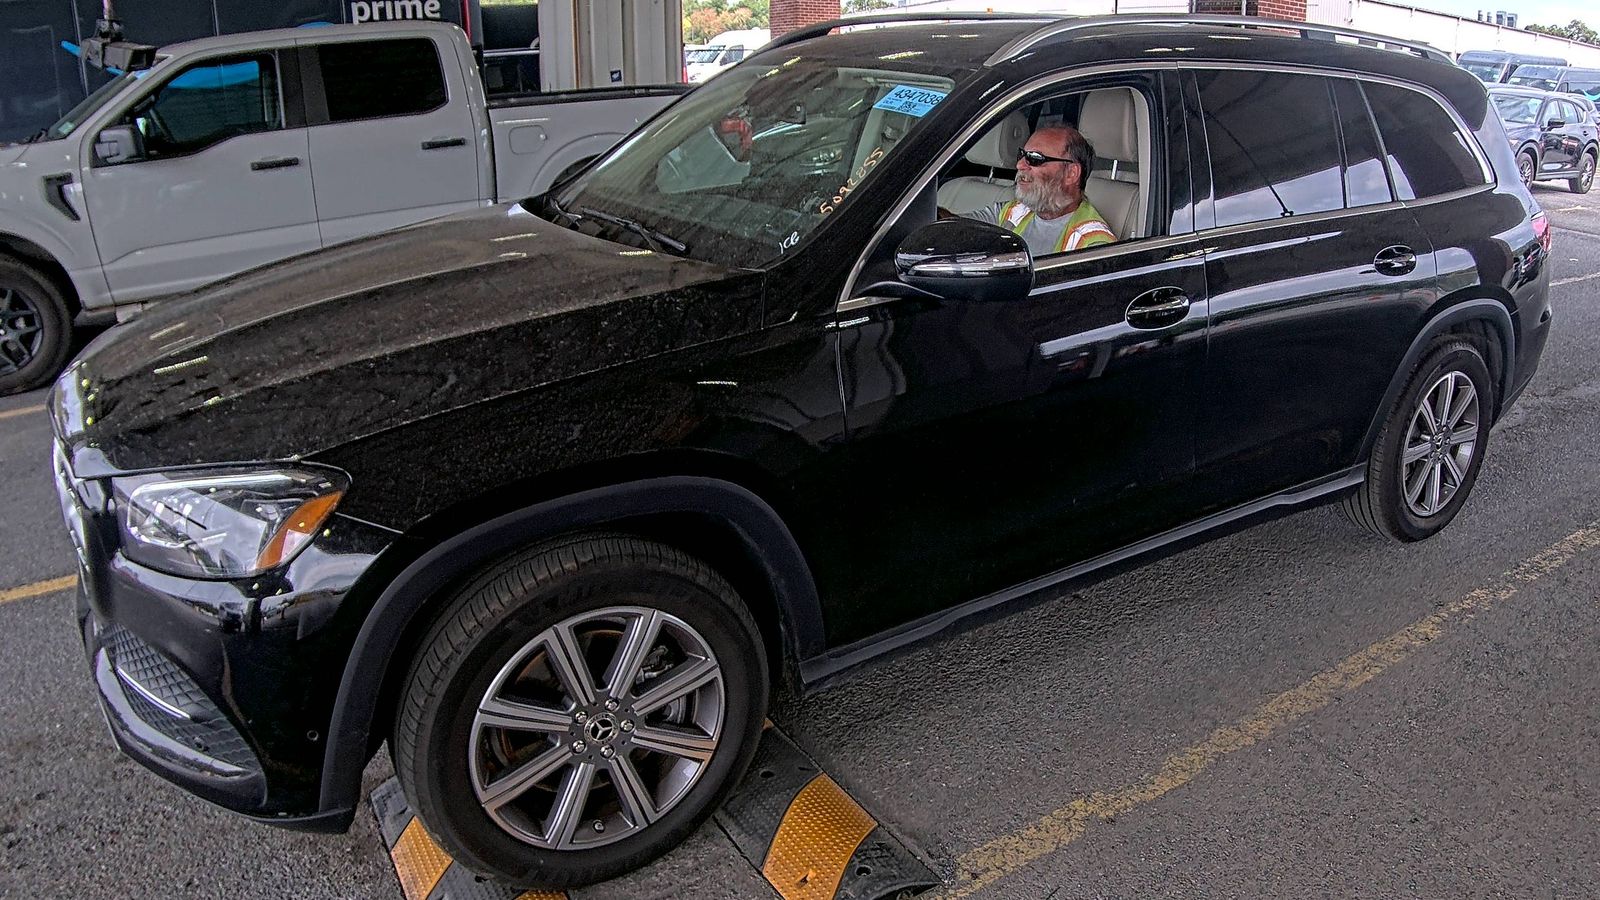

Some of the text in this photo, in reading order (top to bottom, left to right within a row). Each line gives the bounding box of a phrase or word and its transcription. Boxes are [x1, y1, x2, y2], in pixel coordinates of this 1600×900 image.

[351, 0, 441, 25] prime
[895, 89, 944, 105] 4347038
[820, 147, 883, 214] 5092855
